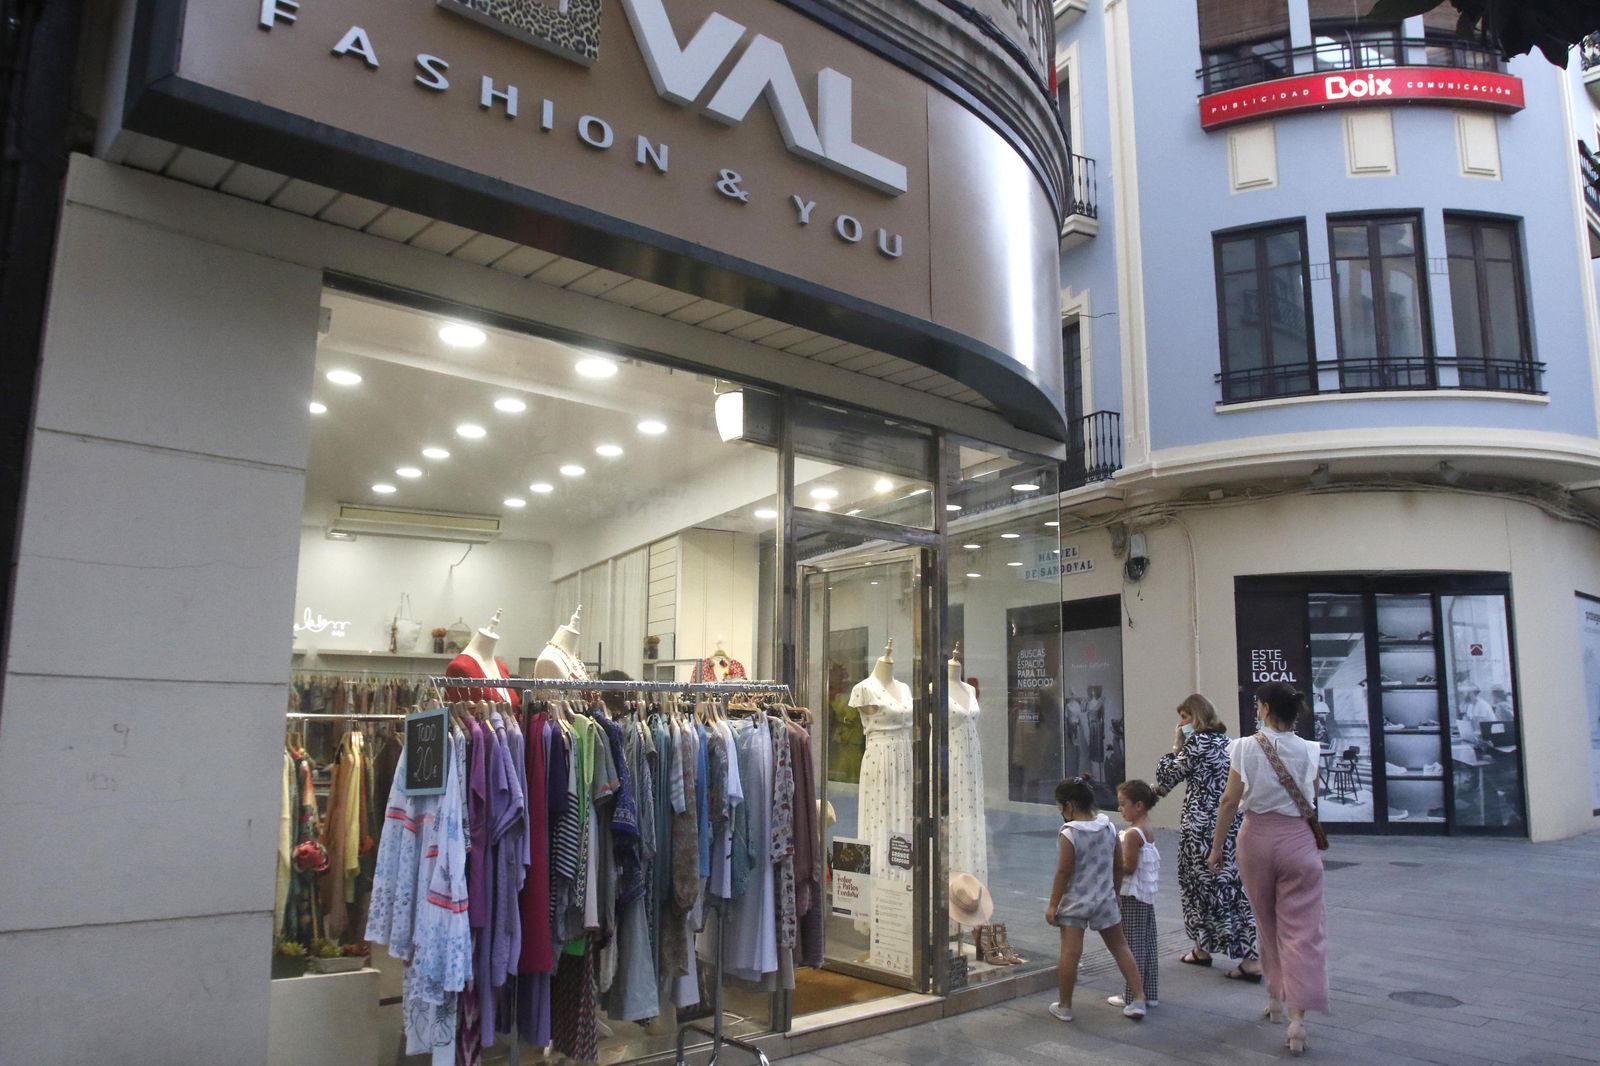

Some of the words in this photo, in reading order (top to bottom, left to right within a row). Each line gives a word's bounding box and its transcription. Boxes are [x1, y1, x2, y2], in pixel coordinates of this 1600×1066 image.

[1211, 88, 1311, 114] PUBLICIDAD
[1325, 73, 1393, 100] Boix
[1406, 80, 1512, 96] COMUNICACIÓN
[258, 0, 670, 175] FASHION
[713, 168, 750, 204] &
[792, 193, 903, 258] YOU
[1025, 569, 1038, 580] DE
[1251, 650, 1282, 660] ESTE
[1017, 658, 1045, 670] ESPACIO
[1252, 660, 1267, 671] ES
[1270, 660, 1288, 671] TU
[1017, 669, 1035, 679] PARA
[1036, 668, 1046, 678] TU
[1252, 671, 1297, 683] LOCAL
[1017, 678, 1054, 689] NEGOCIO?
[416, 723, 437, 742] TODO
